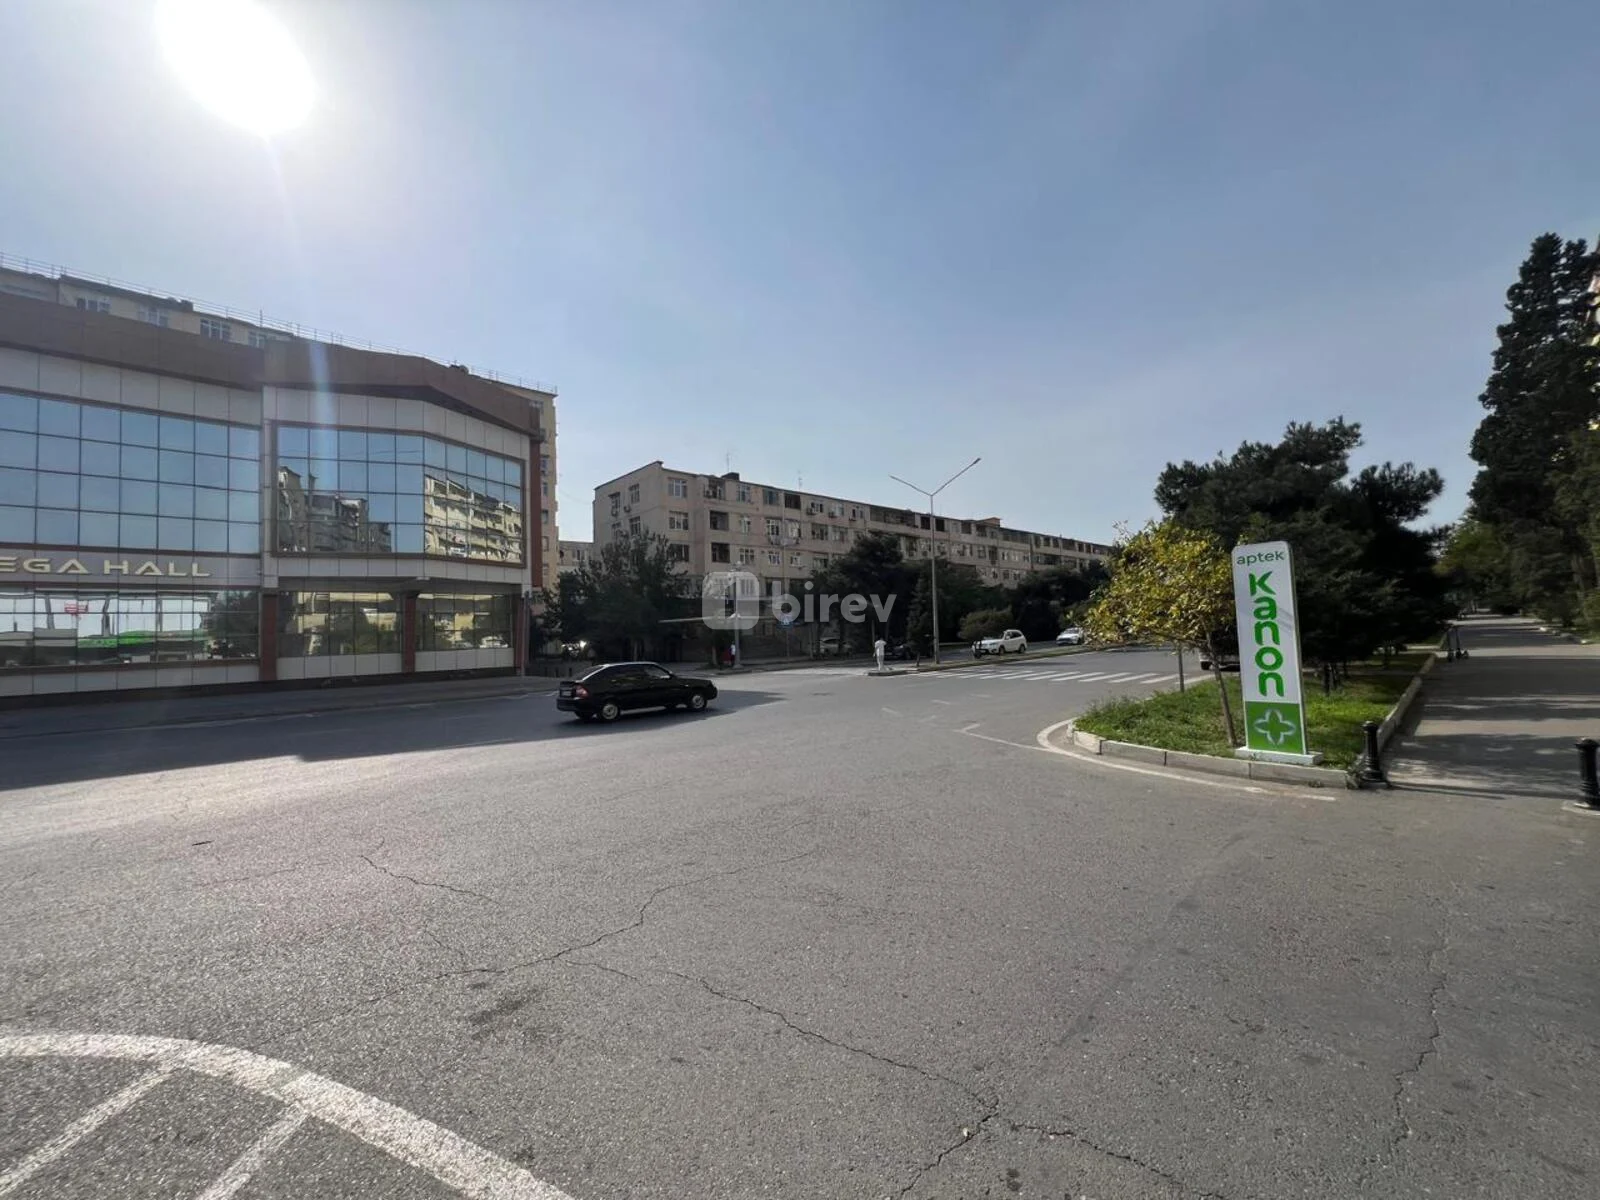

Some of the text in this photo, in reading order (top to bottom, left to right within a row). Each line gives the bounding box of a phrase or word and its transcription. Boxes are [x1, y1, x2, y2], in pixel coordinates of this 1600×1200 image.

[0, 556, 211, 577] EGA HALL
[1236, 550, 1285, 567] aptek
